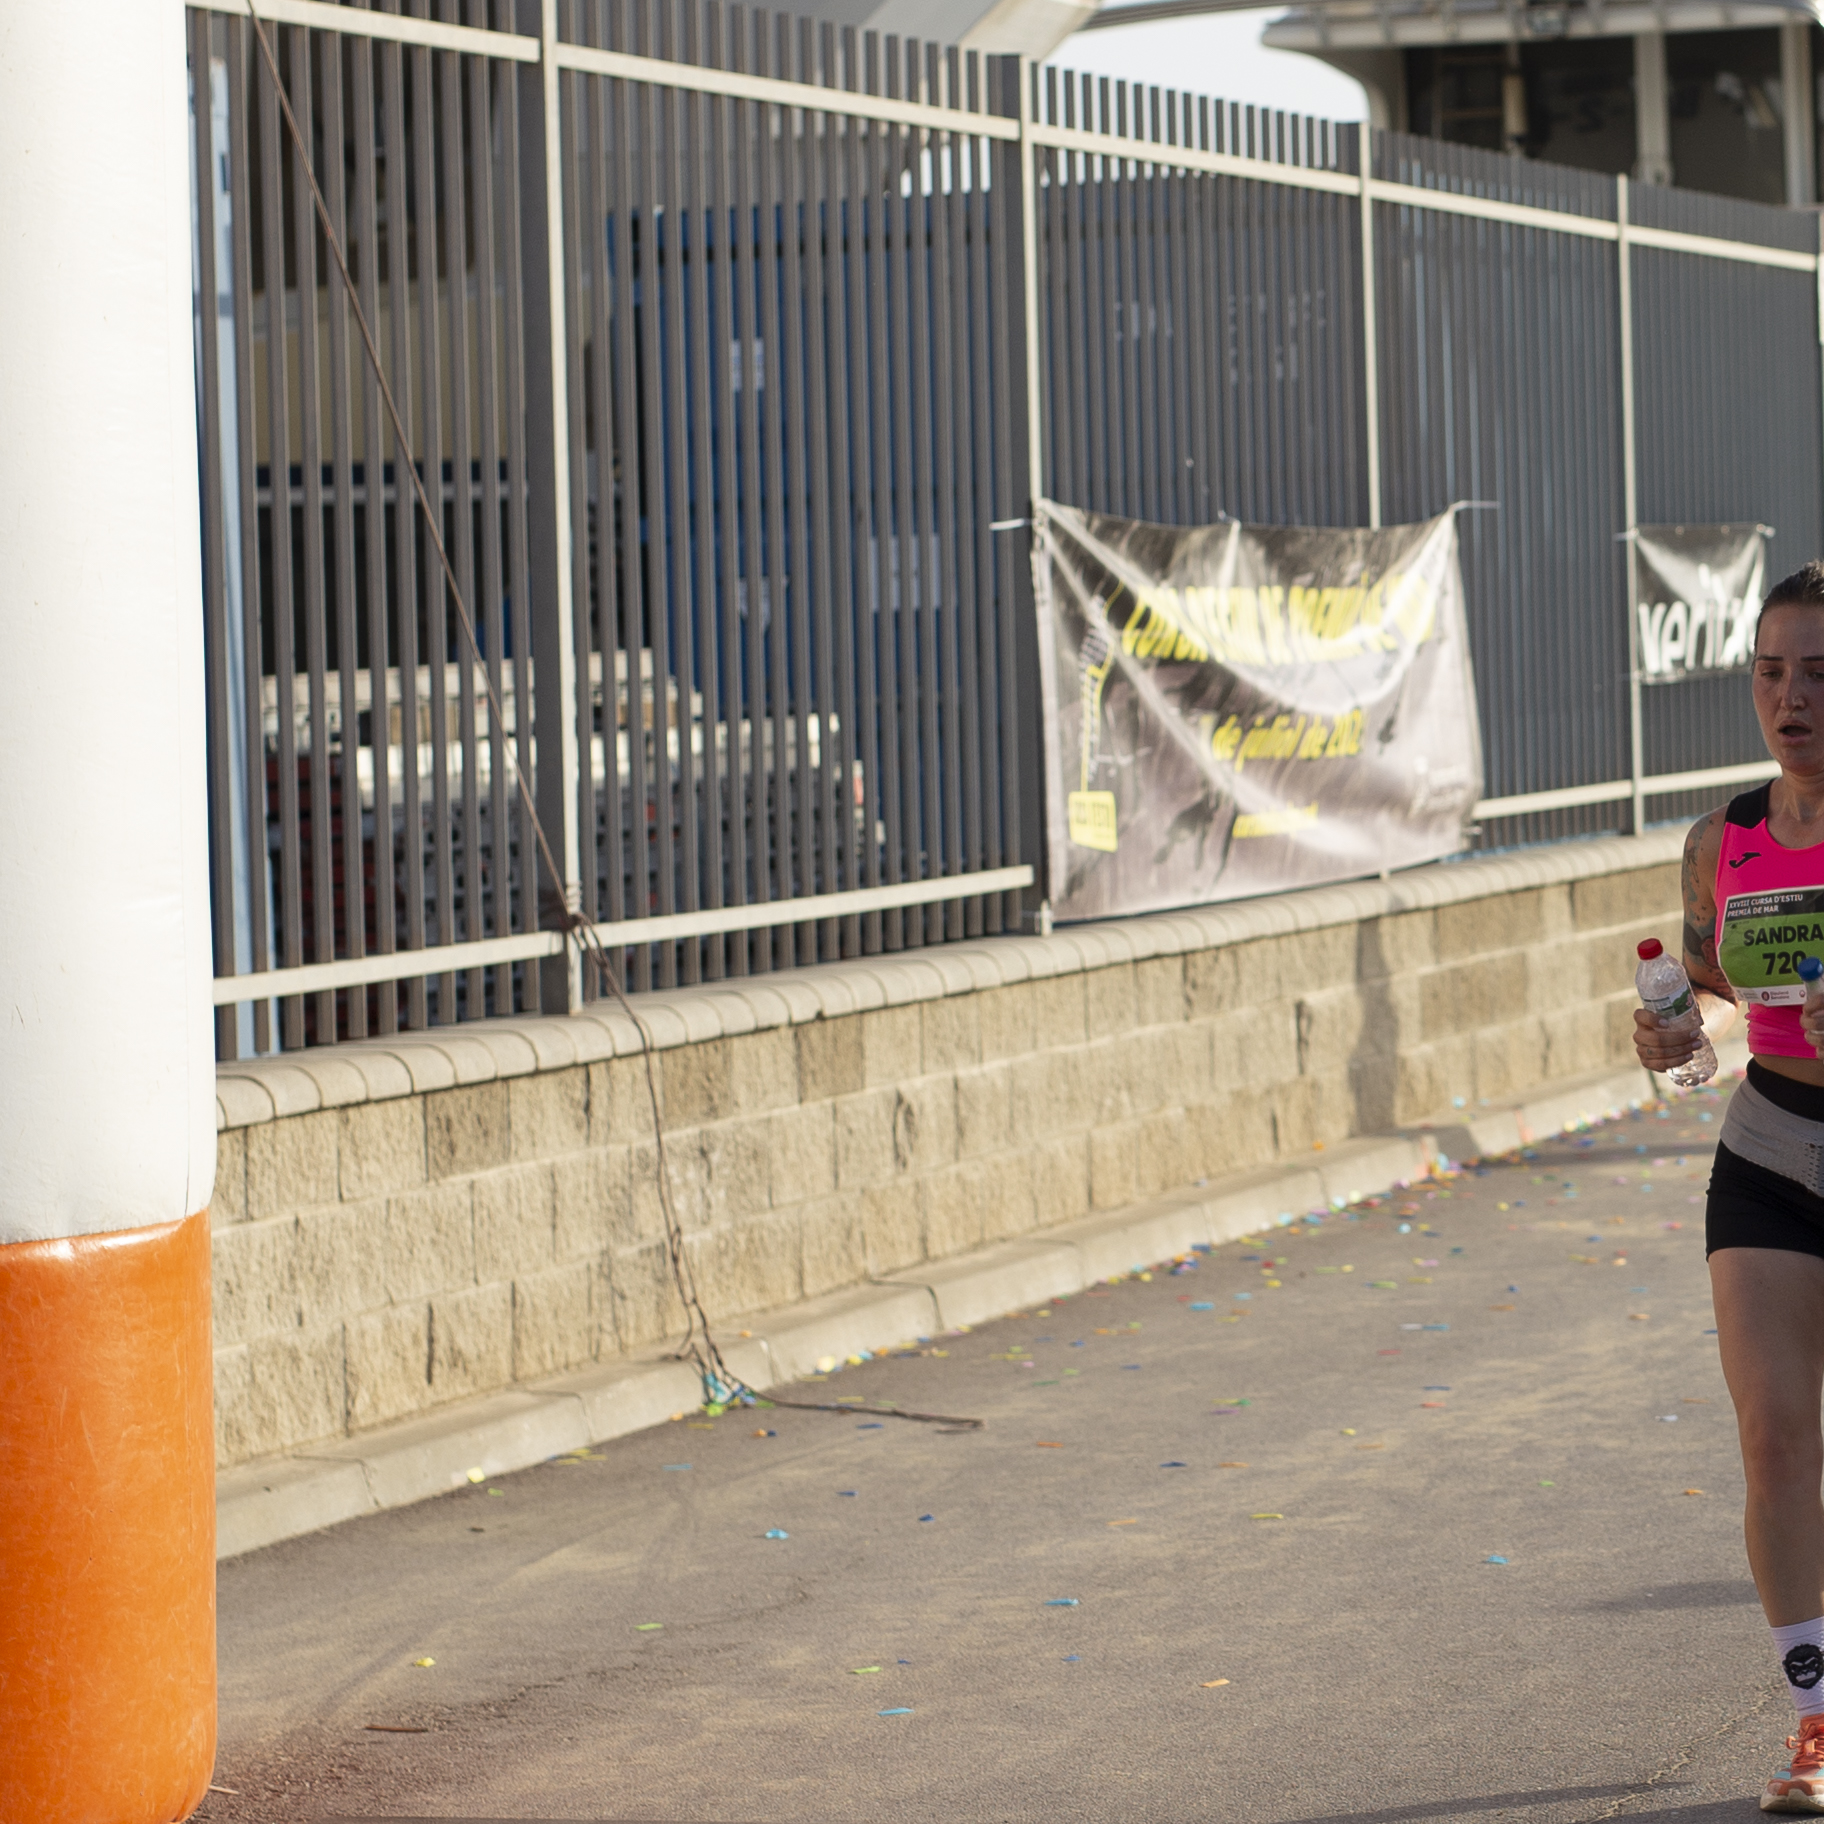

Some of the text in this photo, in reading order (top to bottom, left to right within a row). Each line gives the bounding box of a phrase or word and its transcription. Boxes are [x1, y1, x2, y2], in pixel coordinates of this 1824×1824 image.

[1727, 904, 1780, 918] PREMIÀ DE MAR
[1728, 899, 1750, 910] XXVIII
[1750, 896, 1773, 907] CURSA
[1774, 893, 1804, 904] D'ESTIU
[1743, 923, 1824, 947] SANDRA
[1762, 950, 1807, 976] 720
